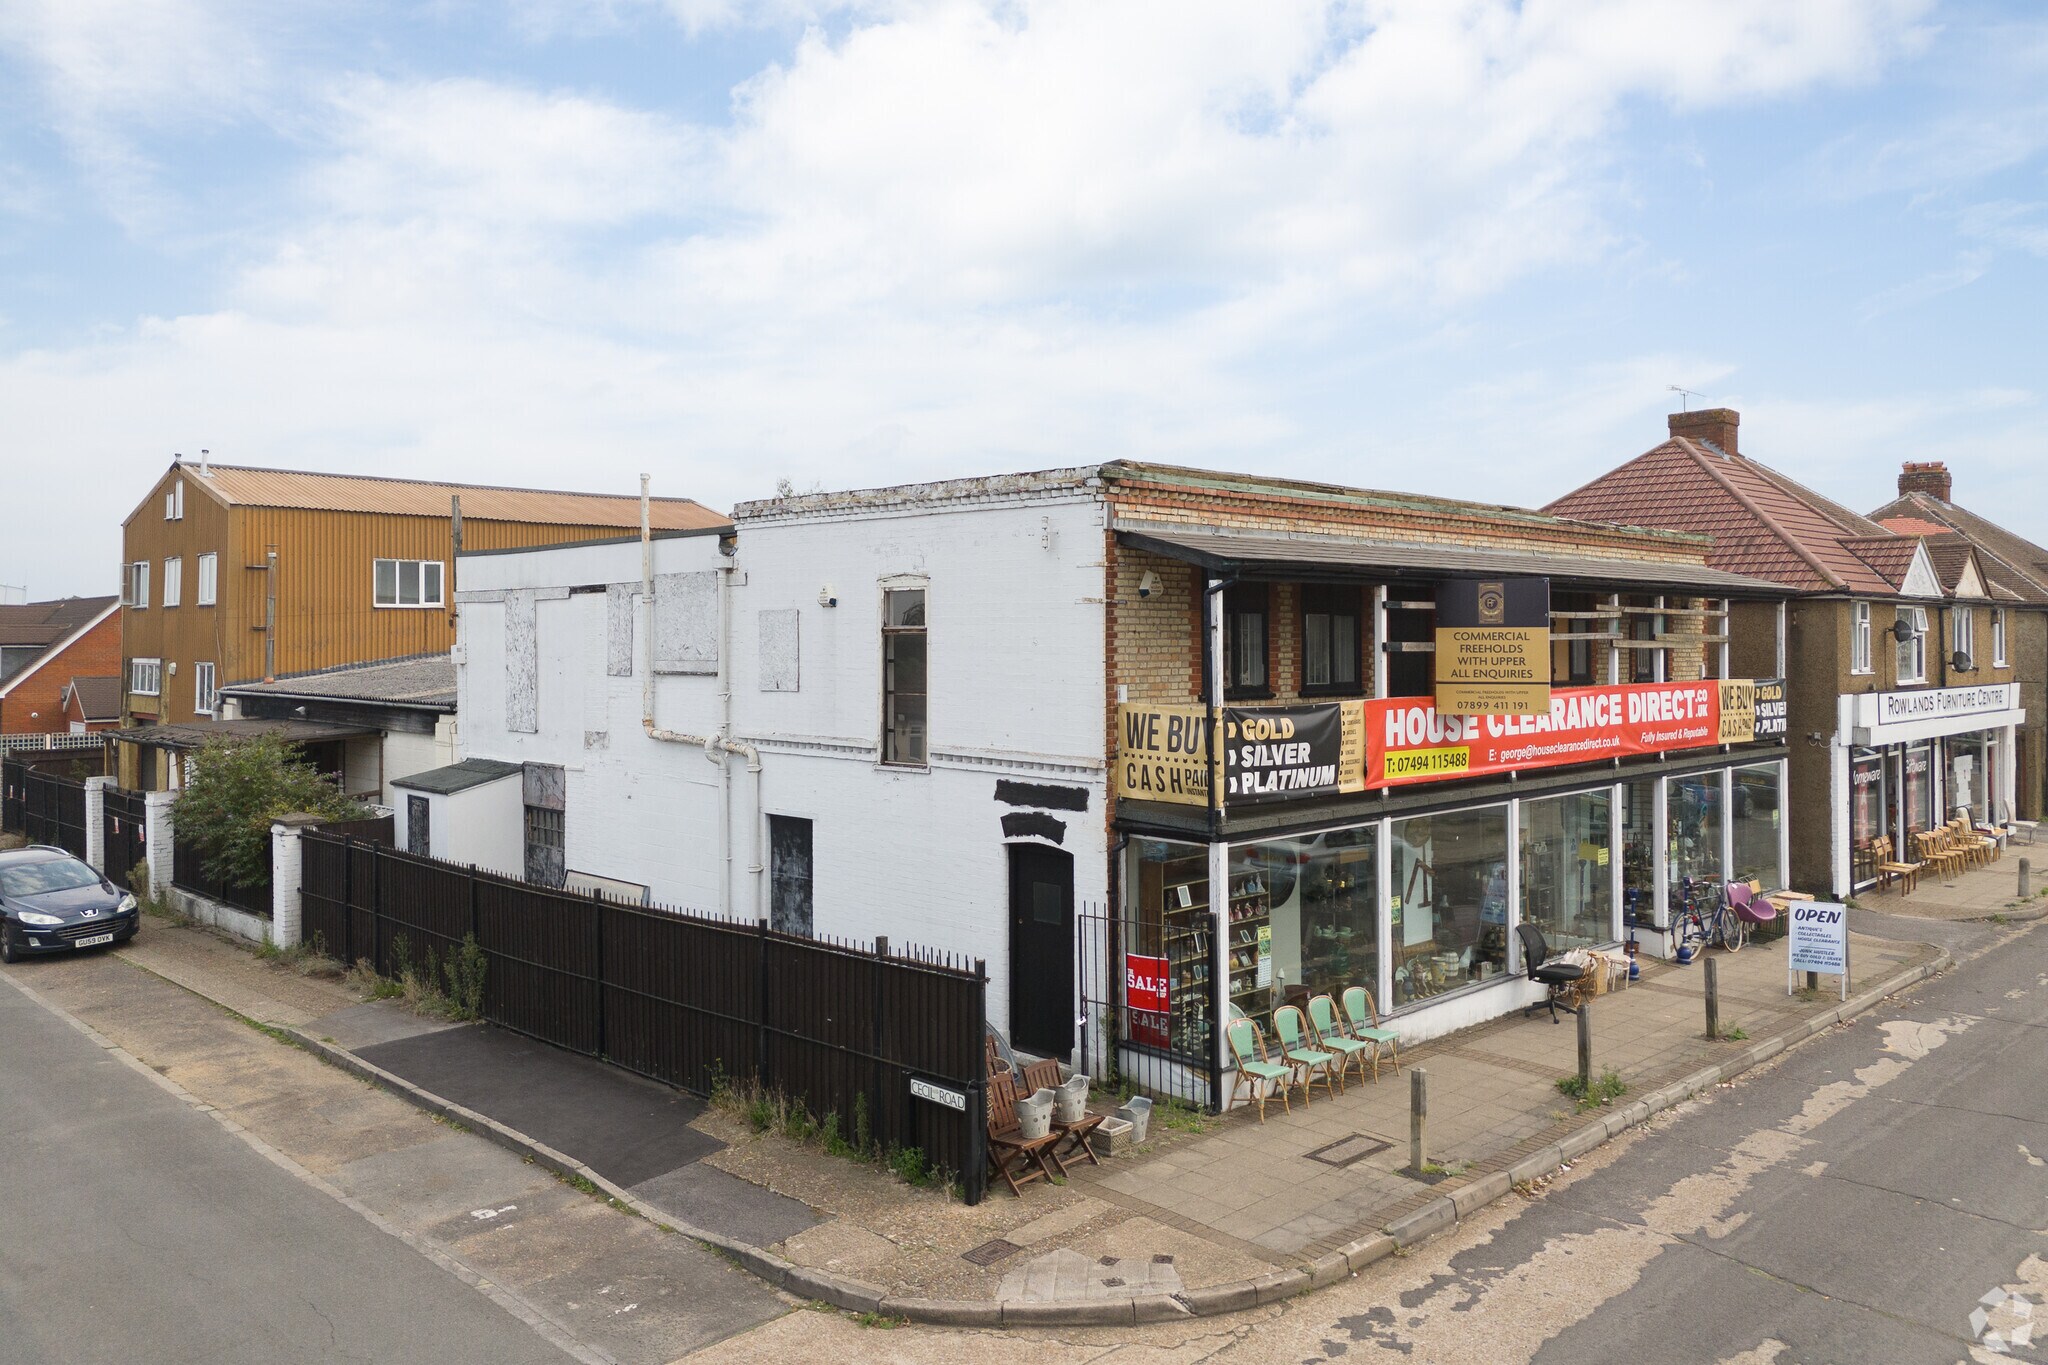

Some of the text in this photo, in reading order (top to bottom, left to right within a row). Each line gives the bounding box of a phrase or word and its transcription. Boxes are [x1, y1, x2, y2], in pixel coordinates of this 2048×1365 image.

[1453, 632, 1530, 641] COMMERCIAL
[1460, 644, 1523, 653] FREEHOLDS
[1458, 657, 1526, 666] WITH UPPER
[1451, 669, 1533, 679] ALL ENQUIRIES
[1722, 686, 1753, 710] WE BUY
[1761, 686, 1782, 700] GOLD
[1888, 689, 2003, 715] ROWLANDS FURNITURE CENTRE
[1457, 702, 1528, 710] 07899 411 191
[1386, 707, 1479, 747] HOUSE
[1487, 694, 1622, 738] CLEARANCE
[1628, 689, 1695, 724] DIRECT
[1722, 719, 1742, 737] CASH
[1126, 711, 1160, 751] WE
[1241, 718, 1295, 741] GOLD
[1641, 731, 1655, 744] Fully
[1656, 729, 1678, 741] Insured
[1683, 726, 1708, 740] Reputable
[1241, 742, 1310, 768] SILVER
[1489, 736, 1620, 762] E: george@houseclearancedirect.co.uk
[1386, 752, 1467, 773] T: 07494 115488
[1127, 762, 1182, 794] CASH
[1242, 764, 1335, 794] PLATINUM
[1795, 908, 1841, 924] OPEN
[1128, 974, 1167, 992] SALE
[1132, 1009, 1168, 1032] SALE
[912, 1081, 965, 1109] CECIL ROAD
